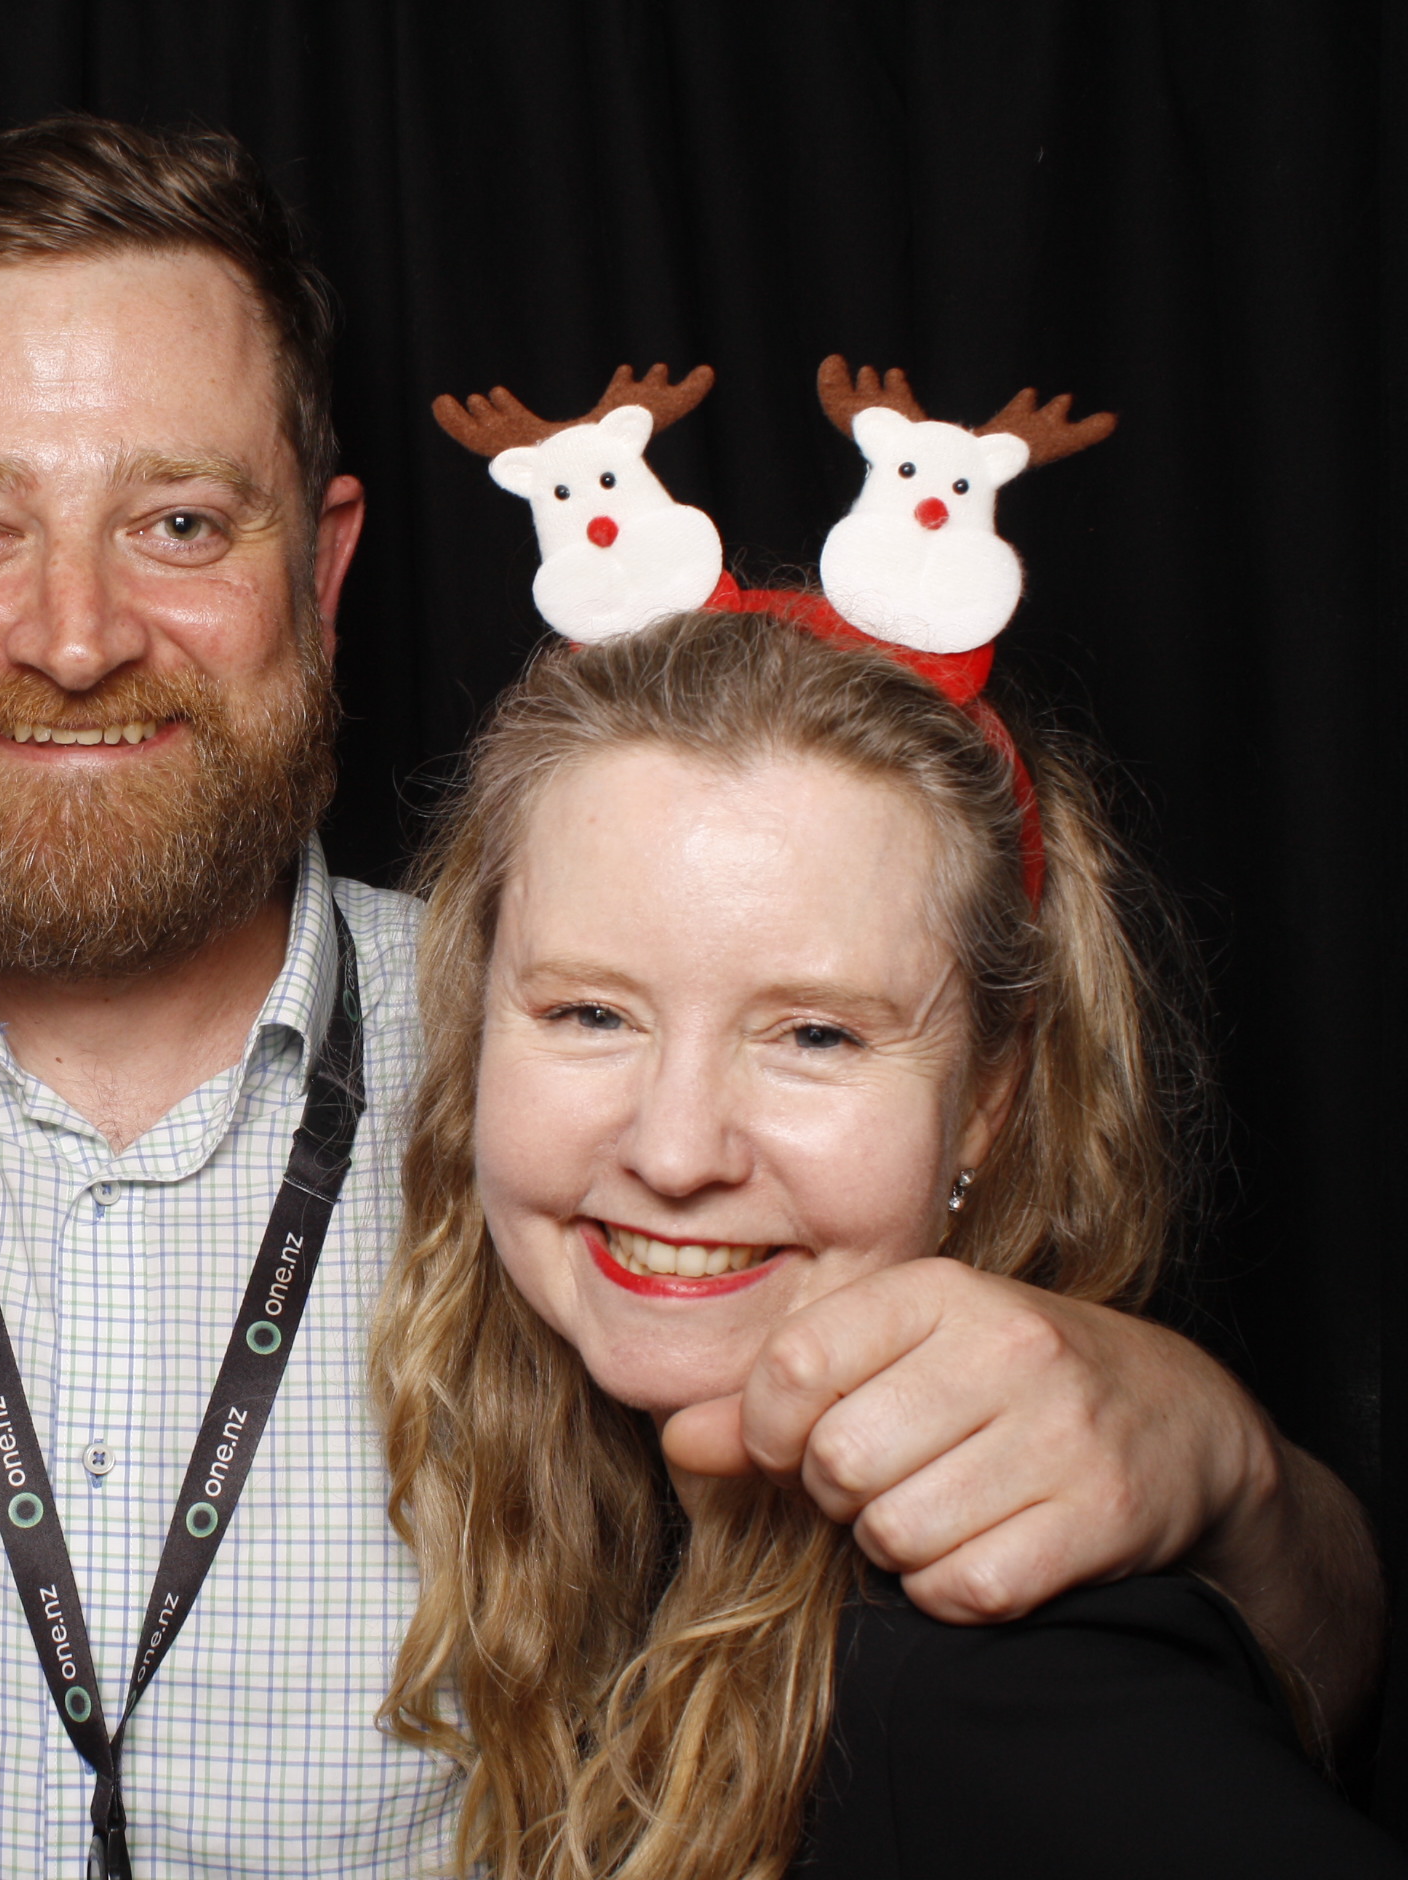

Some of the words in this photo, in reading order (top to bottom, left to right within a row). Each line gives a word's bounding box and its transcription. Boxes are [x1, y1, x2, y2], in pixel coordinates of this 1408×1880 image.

[264, 1231, 304, 1316] one.nz
[204, 1406, 248, 1497] one.nz
[39, 1584, 77, 1680] one.nz
[137, 1592, 180, 1684] one.nz
